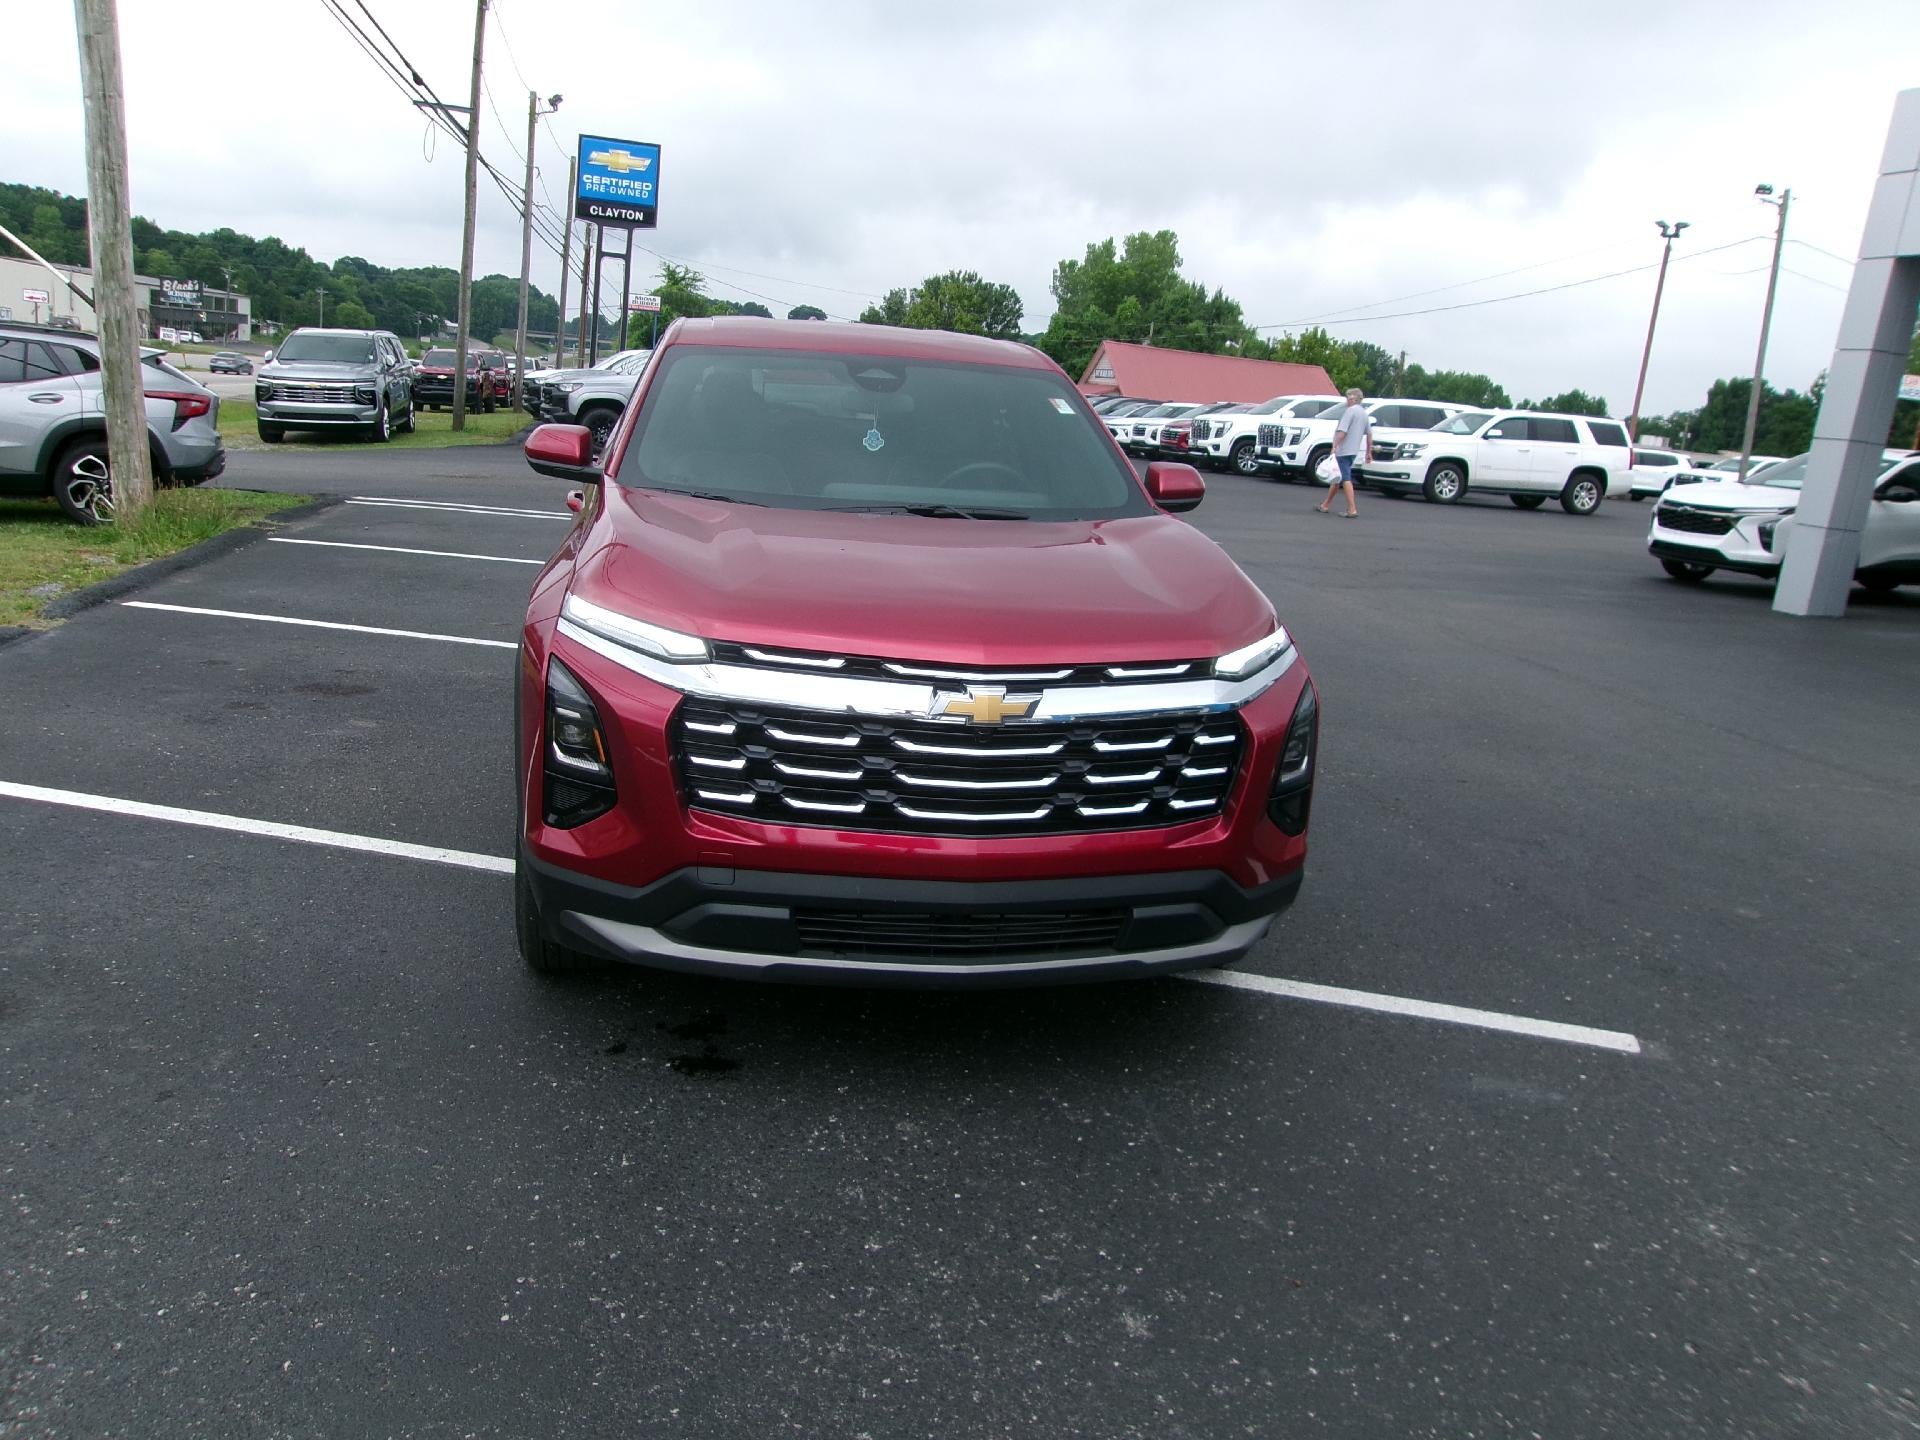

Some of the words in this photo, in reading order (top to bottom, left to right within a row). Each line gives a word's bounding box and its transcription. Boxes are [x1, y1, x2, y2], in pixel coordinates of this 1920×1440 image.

[583, 174, 652, 191] CERTIFIED
[586, 183, 649, 198] PRE-OWNED
[589, 205, 644, 221] CLAYTON
[162, 279, 199, 291] Black's
